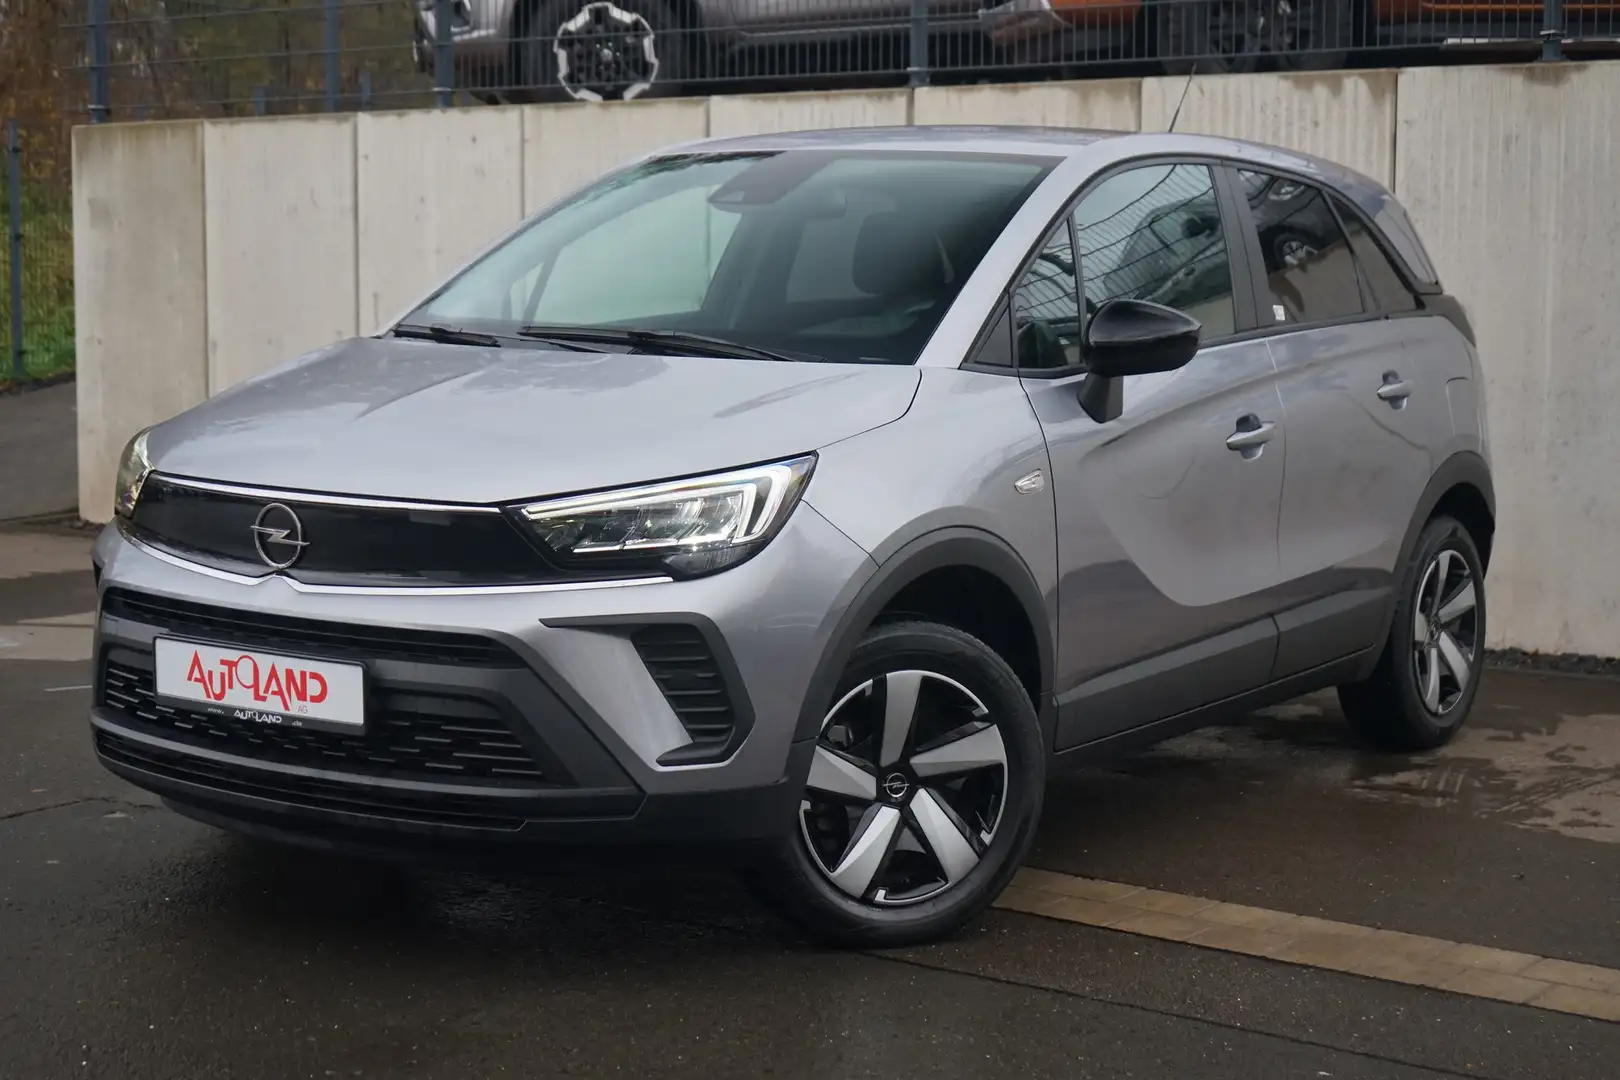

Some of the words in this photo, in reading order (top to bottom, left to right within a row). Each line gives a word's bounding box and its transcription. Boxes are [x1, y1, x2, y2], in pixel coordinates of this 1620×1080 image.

[186, 649, 328, 711] AUTOLAND
[233, 709, 283, 724] AUTOLAND
[296, 704, 308, 714] AG
